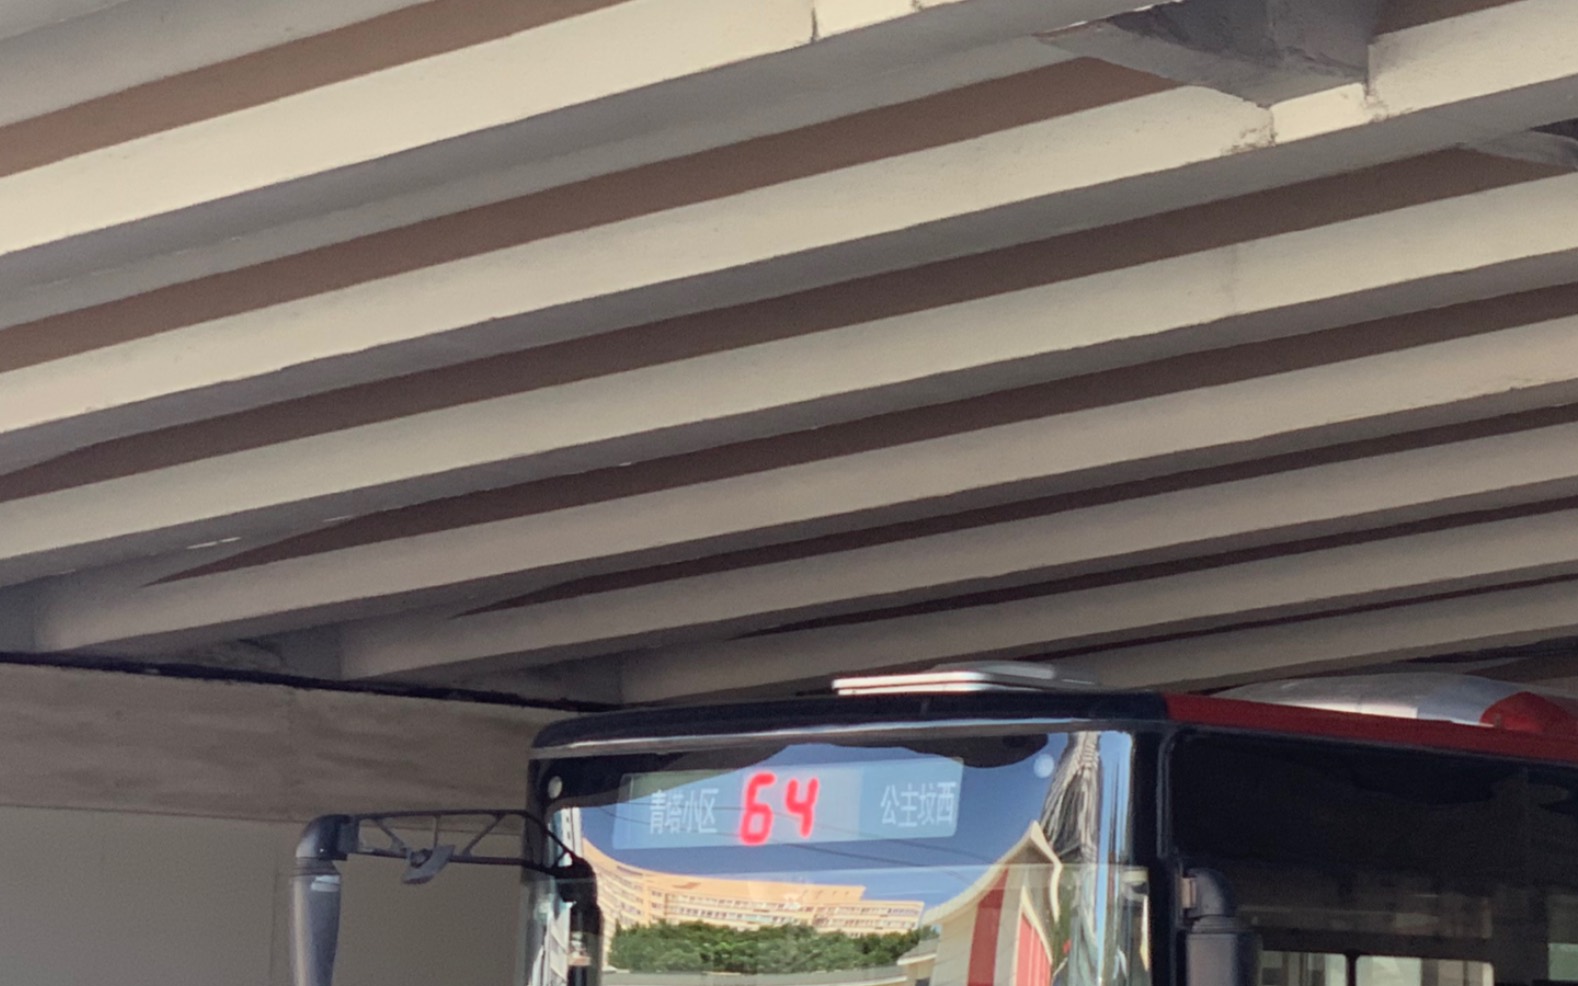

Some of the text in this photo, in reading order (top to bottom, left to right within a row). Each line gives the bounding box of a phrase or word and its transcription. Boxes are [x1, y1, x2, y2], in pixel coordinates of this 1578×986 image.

[648, 788, 720, 834] 青塔小区
[739, 771, 820, 847] 64
[880, 781, 957, 827] 公主坟西
